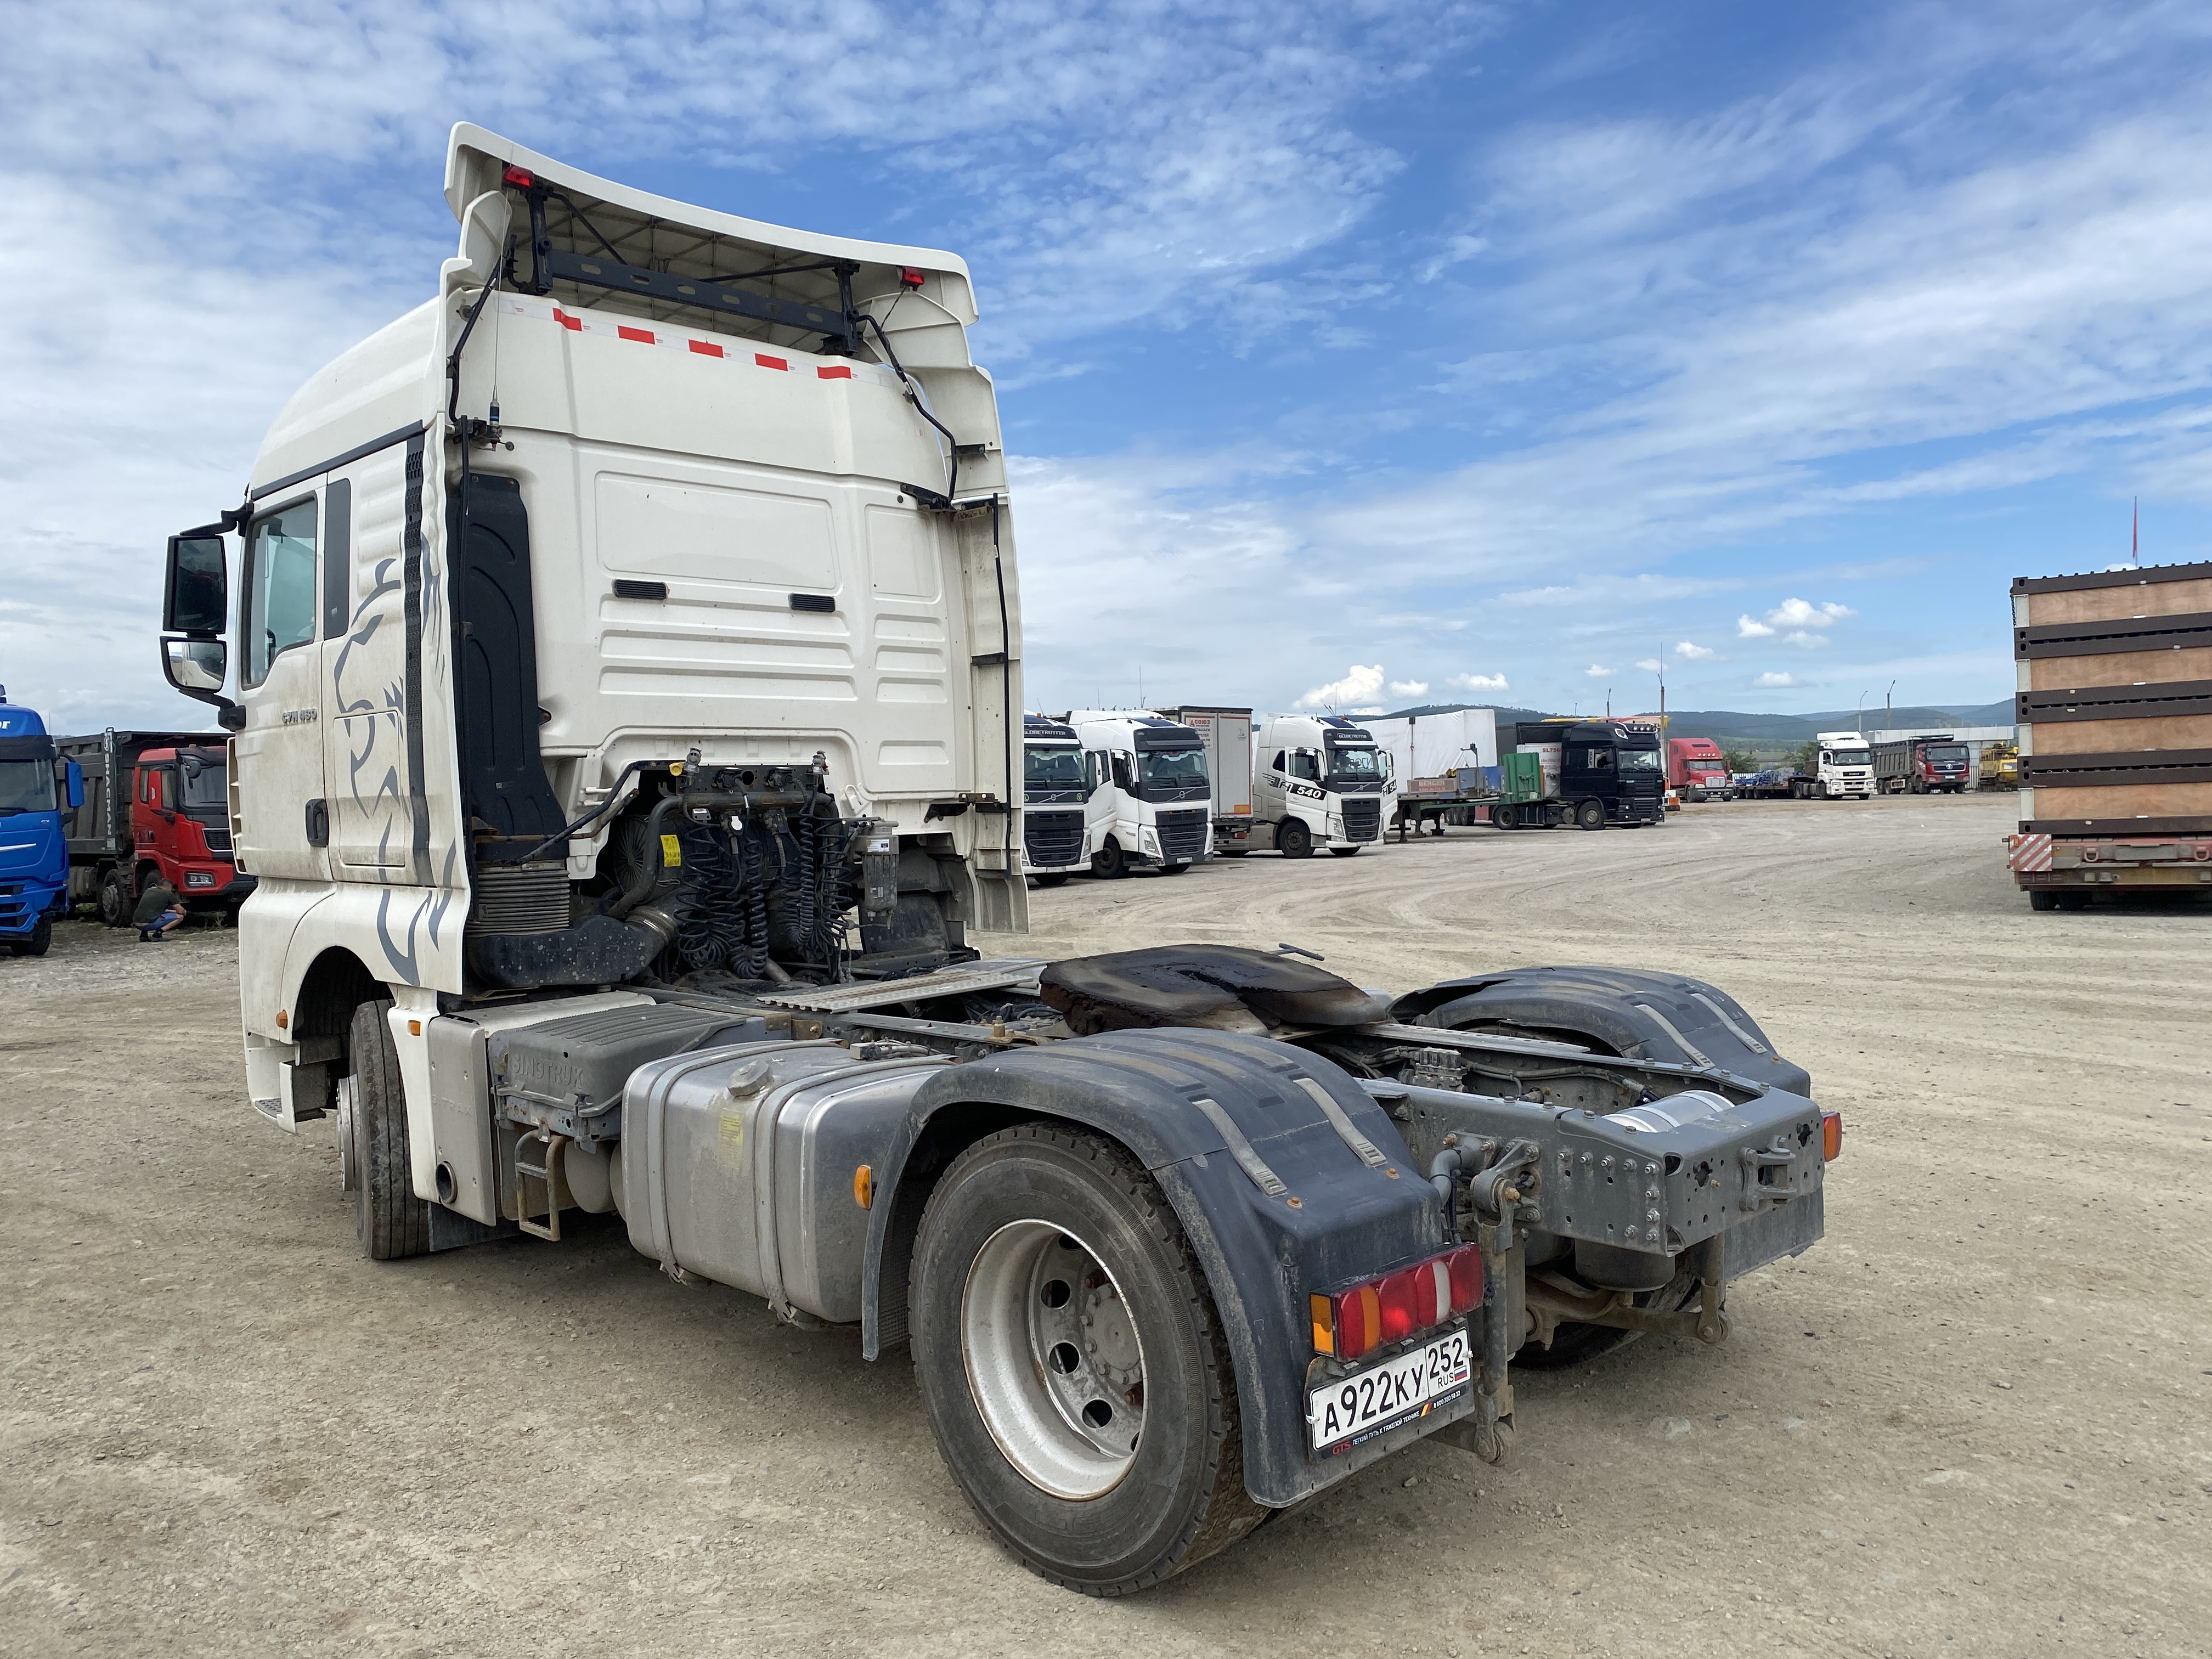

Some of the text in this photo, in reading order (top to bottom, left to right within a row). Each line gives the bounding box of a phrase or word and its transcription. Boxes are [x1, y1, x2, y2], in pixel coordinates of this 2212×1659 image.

[1296, 786, 1322, 798] 540
[511, 1053, 583, 1089] SINOTRUK
[1324, 1337, 1464, 1437] А922КУ 252
[1438, 1373, 1455, 1389] RUS
[1332, 1441, 1351, 1455] GTS
[1369, 1429, 1379, 1439] ПУТЬ
[1403, 1410, 1420, 1423] ТЕХНИКЕ
